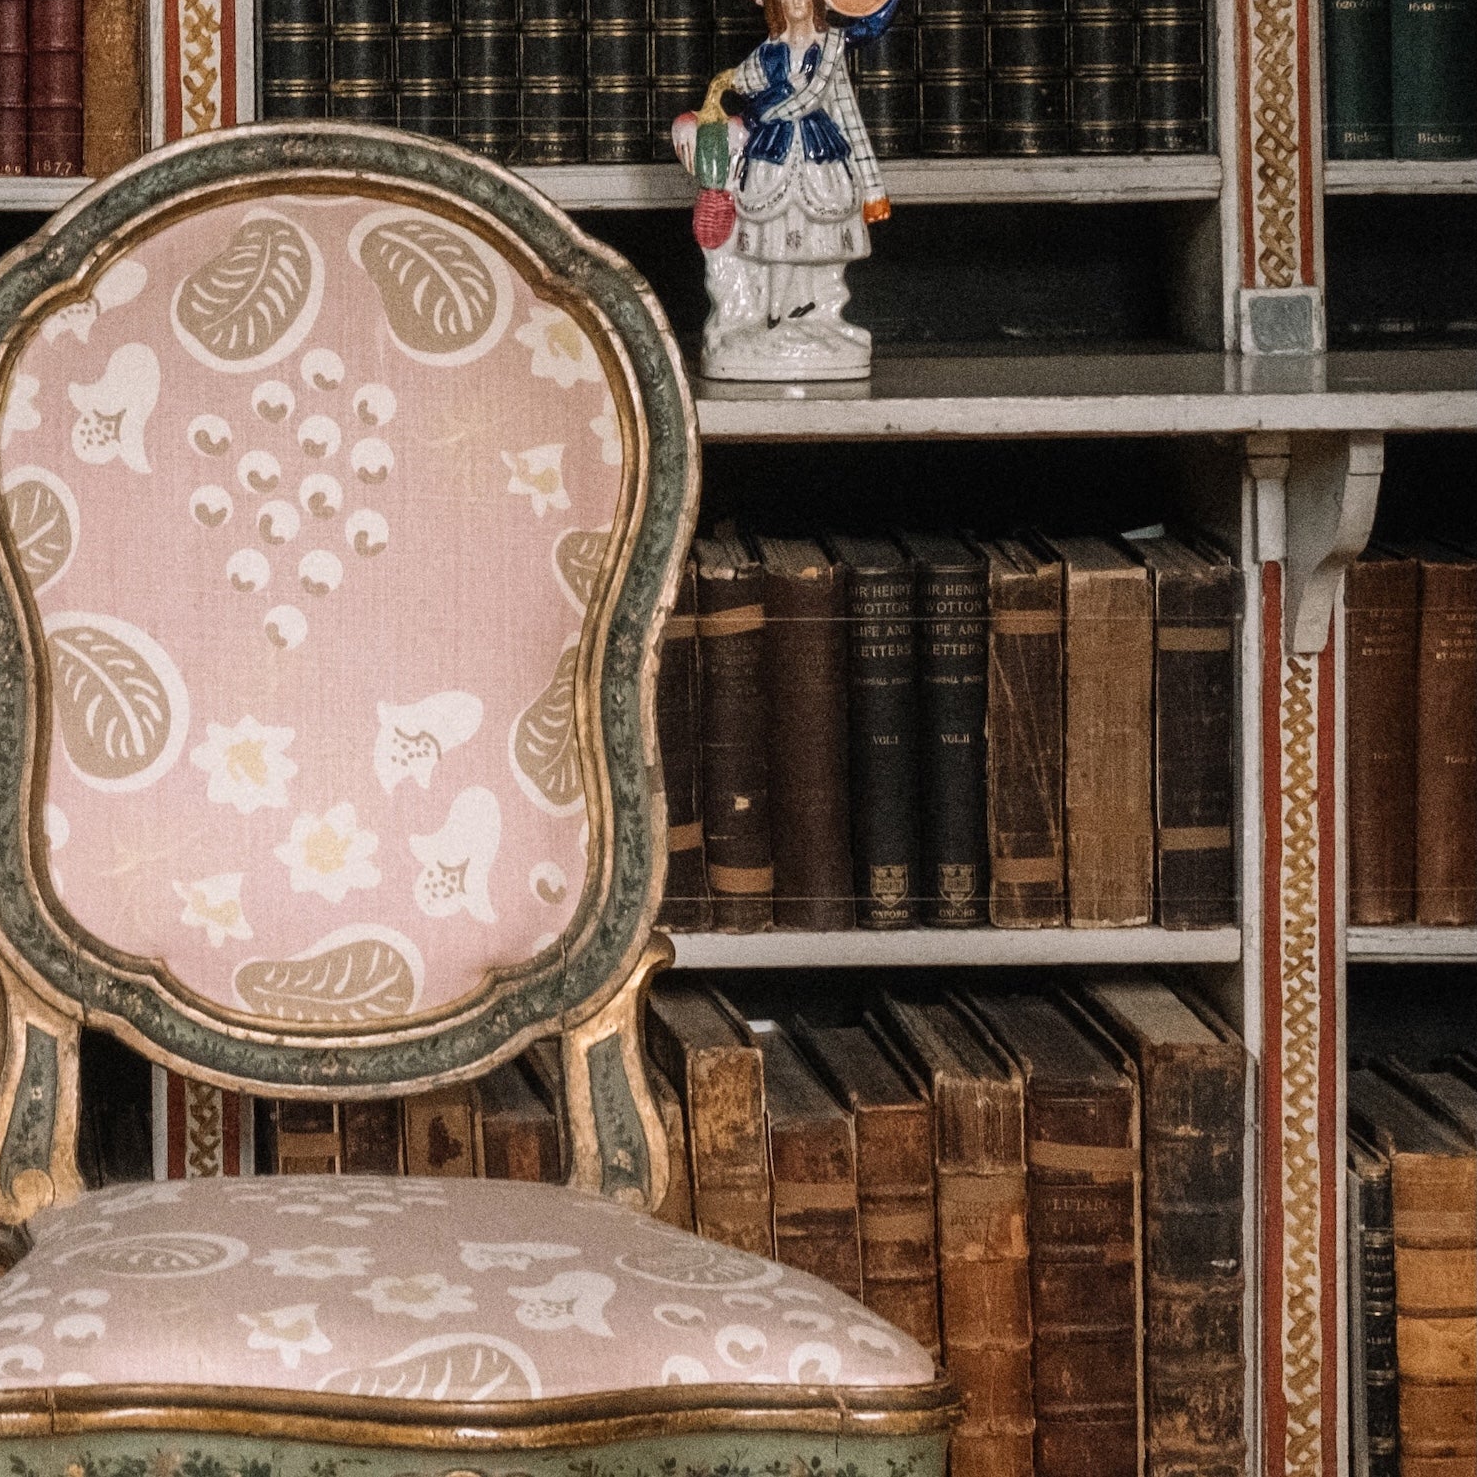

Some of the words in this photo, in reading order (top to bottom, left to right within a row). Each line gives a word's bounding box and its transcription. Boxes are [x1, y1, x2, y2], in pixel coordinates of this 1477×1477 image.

[35, 160, 72, 176] 1877
[874, 584, 911, 598] HENRY
[945, 584, 984, 597] HENRY
[853, 602, 910, 615] WOTTON
[926, 601, 982, 614] WOTTON
[853, 624, 880, 637] LIFE
[886, 624, 911, 636] AND
[958, 623, 982, 636] AND
[853, 644, 912, 658] LETTERS
[870, 910, 909, 919] OXFORD
[938, 909, 976, 918] OXFORD
